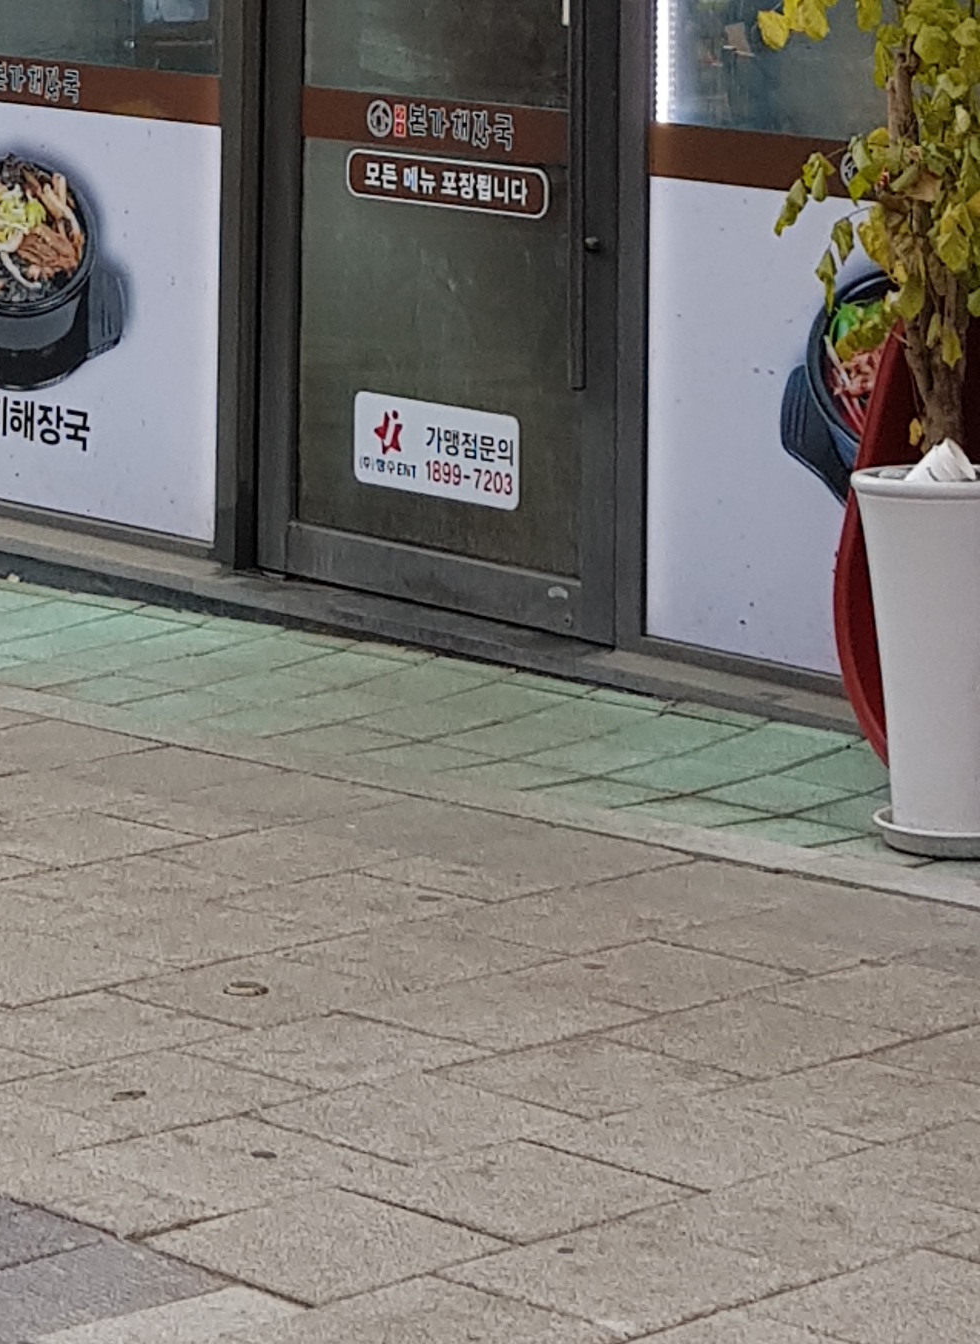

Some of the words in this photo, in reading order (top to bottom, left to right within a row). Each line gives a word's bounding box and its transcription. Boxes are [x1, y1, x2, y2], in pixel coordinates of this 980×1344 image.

[363, 161, 398, 191] 모든
[402, 165, 437, 195] 메뉴
[440, 170, 528, 207] 포장됩니다
[425, 426, 515, 467] 가맹점문의
[425, 459, 513, 496] 1899-7203
